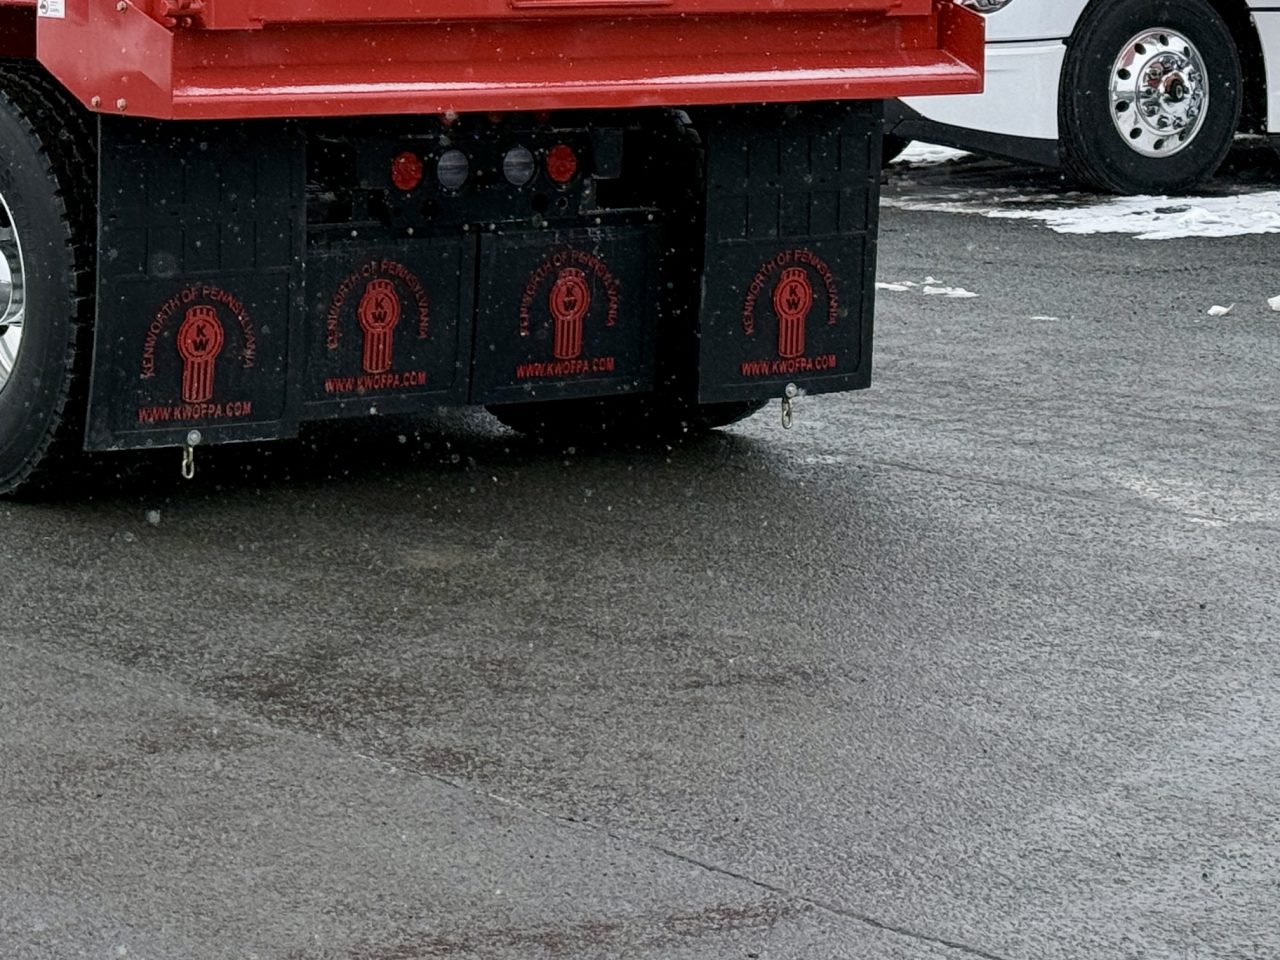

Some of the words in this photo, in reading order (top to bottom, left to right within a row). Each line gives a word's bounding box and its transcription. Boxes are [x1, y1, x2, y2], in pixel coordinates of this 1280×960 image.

[742, 259, 777, 335] KENWORTH
[777, 250, 793, 265] OF
[794, 249, 838, 325] PENNSYLVANIA
[141, 294, 181, 378] KENWORTH
[181, 287, 199, 303] OF
[202, 286, 256, 368] PENNSYLVANIA
[741, 354, 837, 376] WWW.KWOFPA.COM
[138, 401, 252, 422] WWW.KWOFPA.COM
